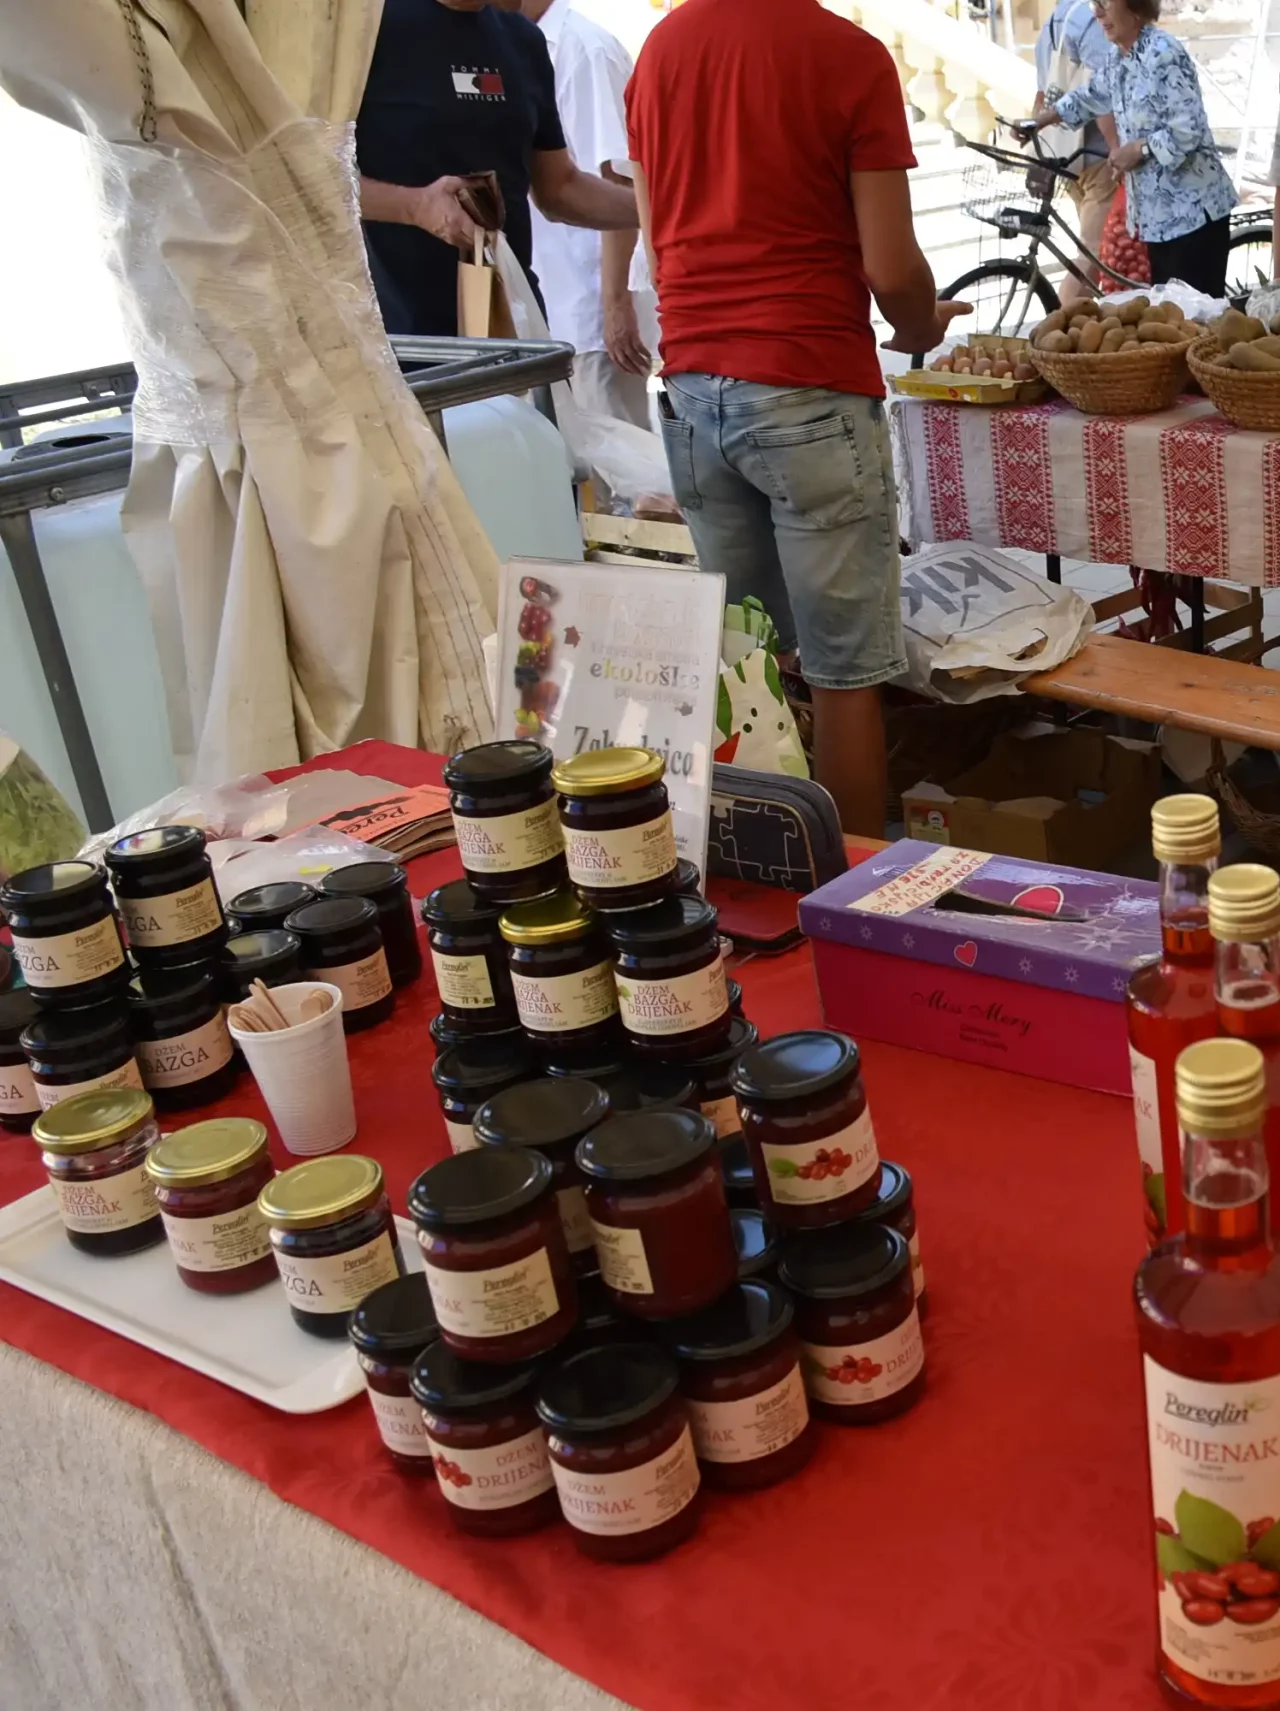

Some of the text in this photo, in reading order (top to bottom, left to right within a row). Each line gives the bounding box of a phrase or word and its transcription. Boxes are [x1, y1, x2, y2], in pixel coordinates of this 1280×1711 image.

[450, 64, 499, 73] TOMMY
[456, 93, 506, 101] HILFIGER
[21, 954, 61, 972] ZGA
[637, 984, 671, 996] DŽEM
[633, 993, 679, 1006] BAZGA
[628, 1001, 694, 1019] DRIJENAK
[1164, 1391, 1248, 1428] Pereglin
[1156, 1421, 1279, 1463] DRIJENAK
[477, 1456, 551, 1489] DRIJENA
